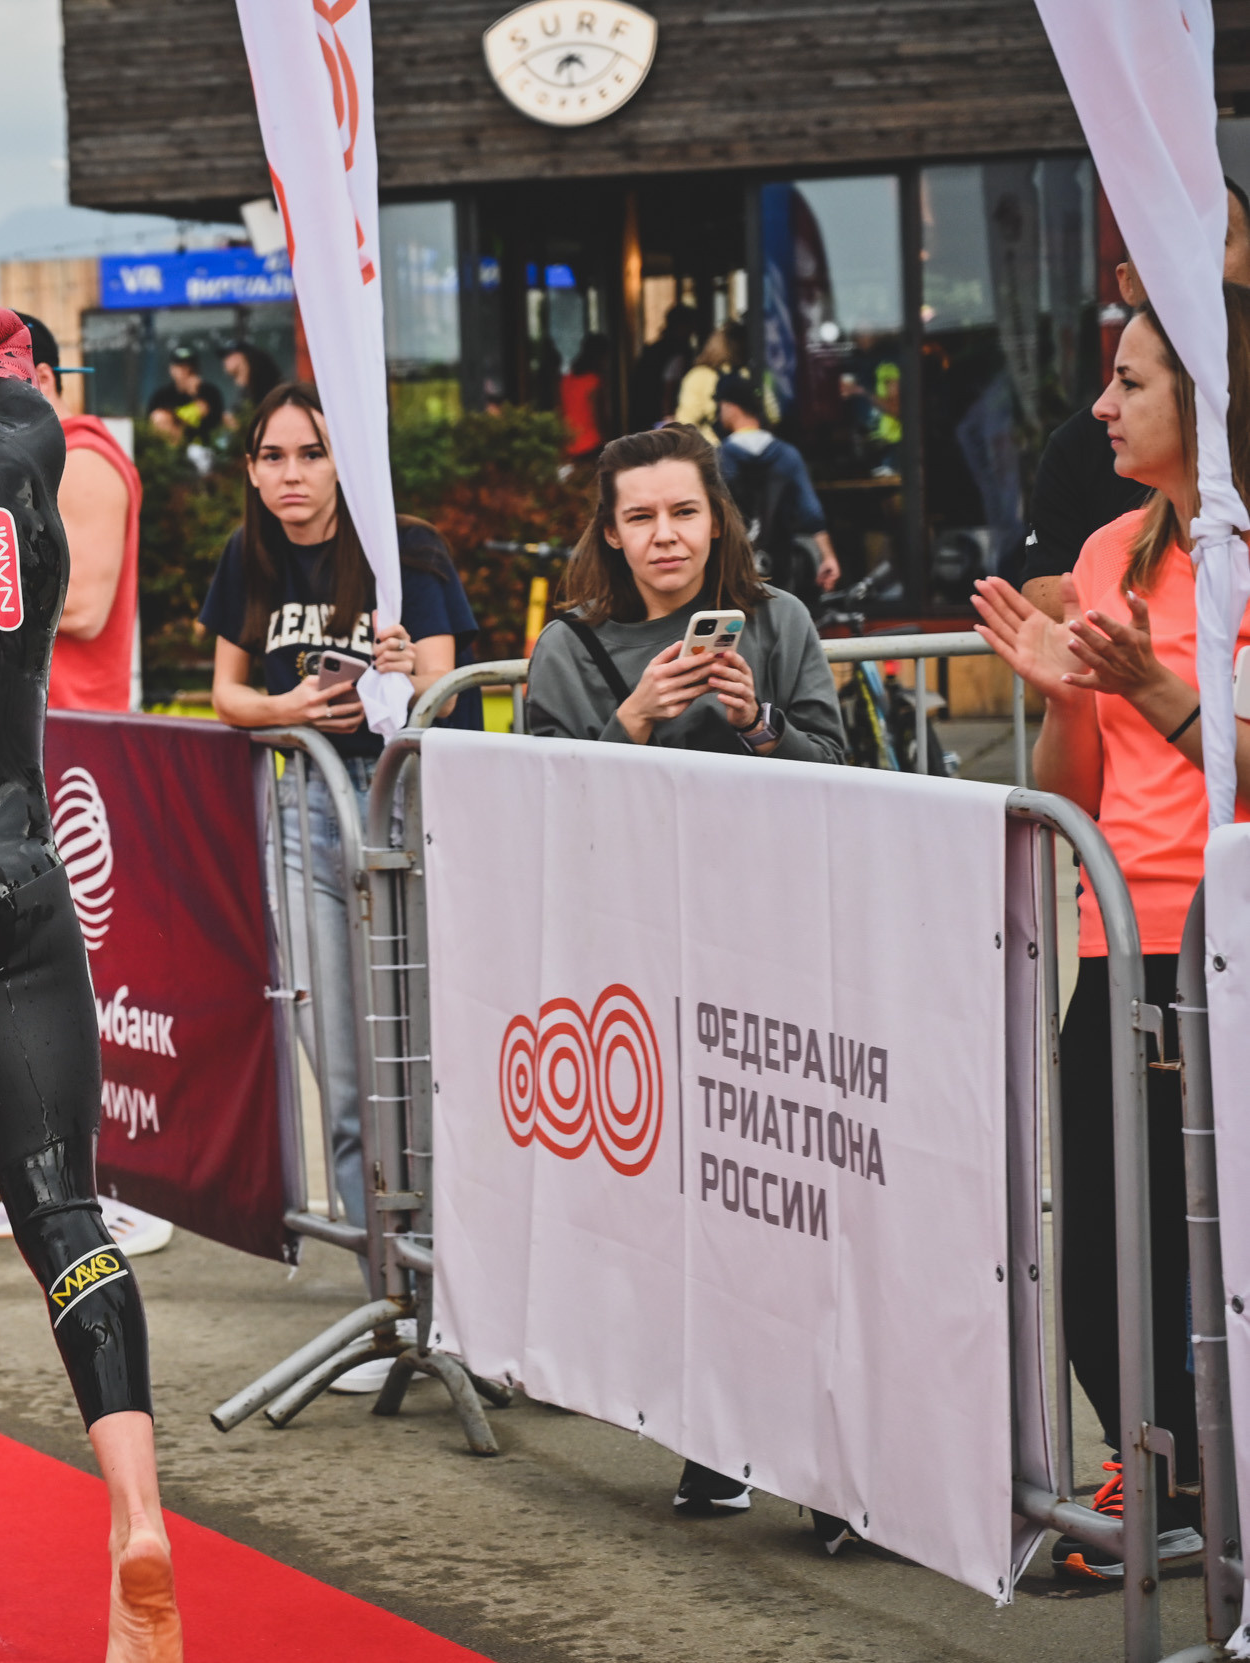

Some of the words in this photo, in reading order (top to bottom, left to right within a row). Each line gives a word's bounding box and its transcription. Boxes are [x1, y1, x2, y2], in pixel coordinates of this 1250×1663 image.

[508, 11, 630, 51] SURF
[518, 73, 626, 109] COFFEE
[119, 265, 163, 293] VR
[697, 1002, 888, 1104] ФЕДЕРАЦИЯ
[698, 1075, 886, 1187] ТРИАТЛОНА
[701, 1152, 828, 1241] РОССИИ
